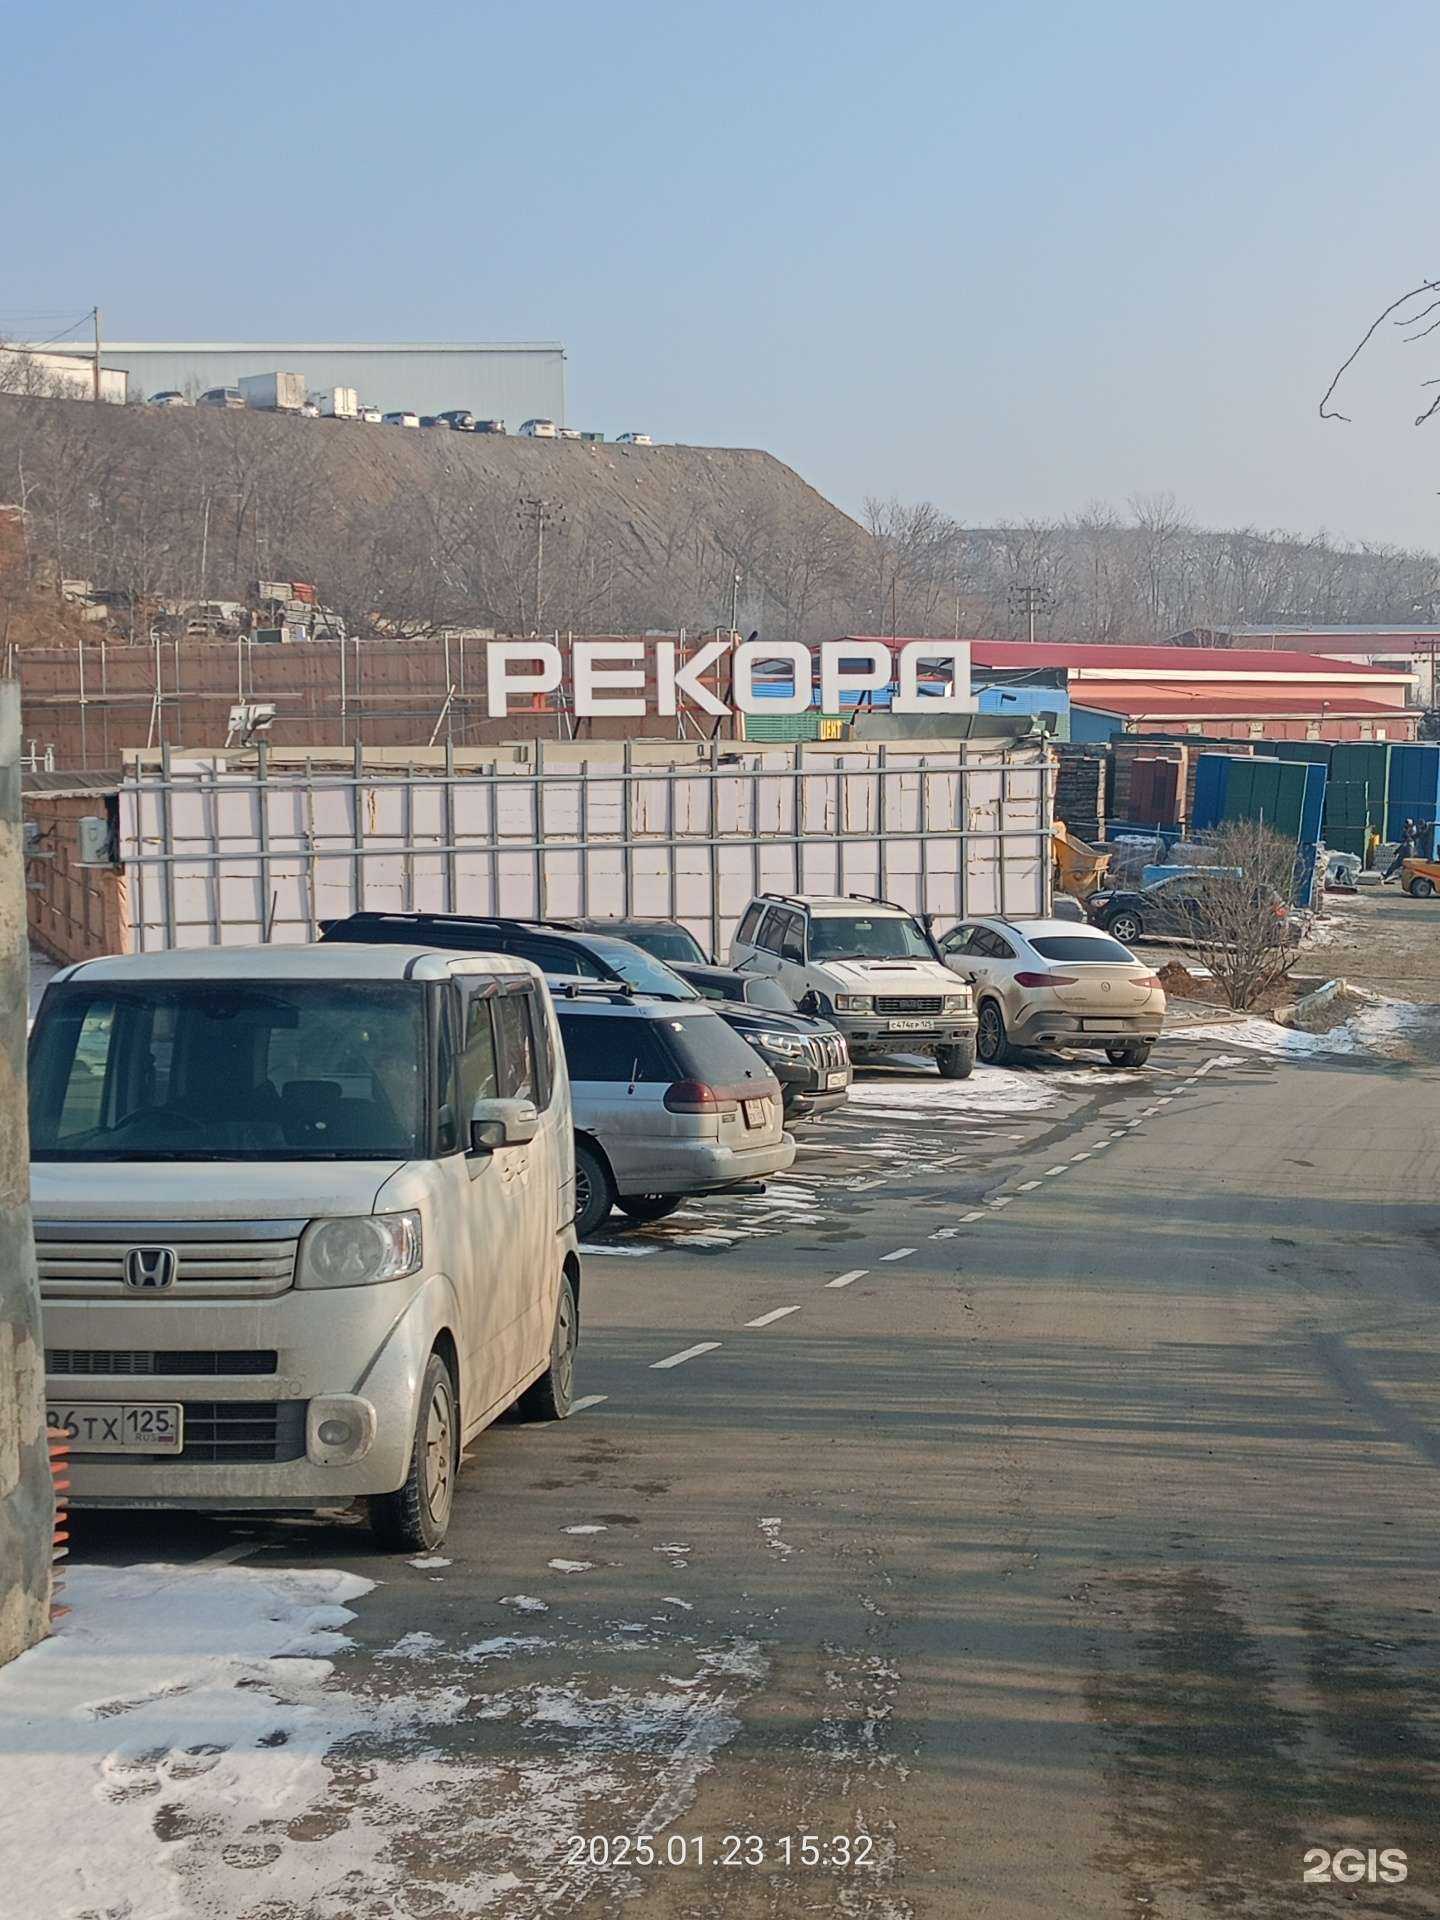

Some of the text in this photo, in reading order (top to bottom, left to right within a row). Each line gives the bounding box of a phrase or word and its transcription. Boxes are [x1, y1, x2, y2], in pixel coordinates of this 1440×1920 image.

[486, 641, 979, 718] РЕКОРД
[126, 1410, 170, 1432] 125
[135, 1434, 157, 1442] RUS
